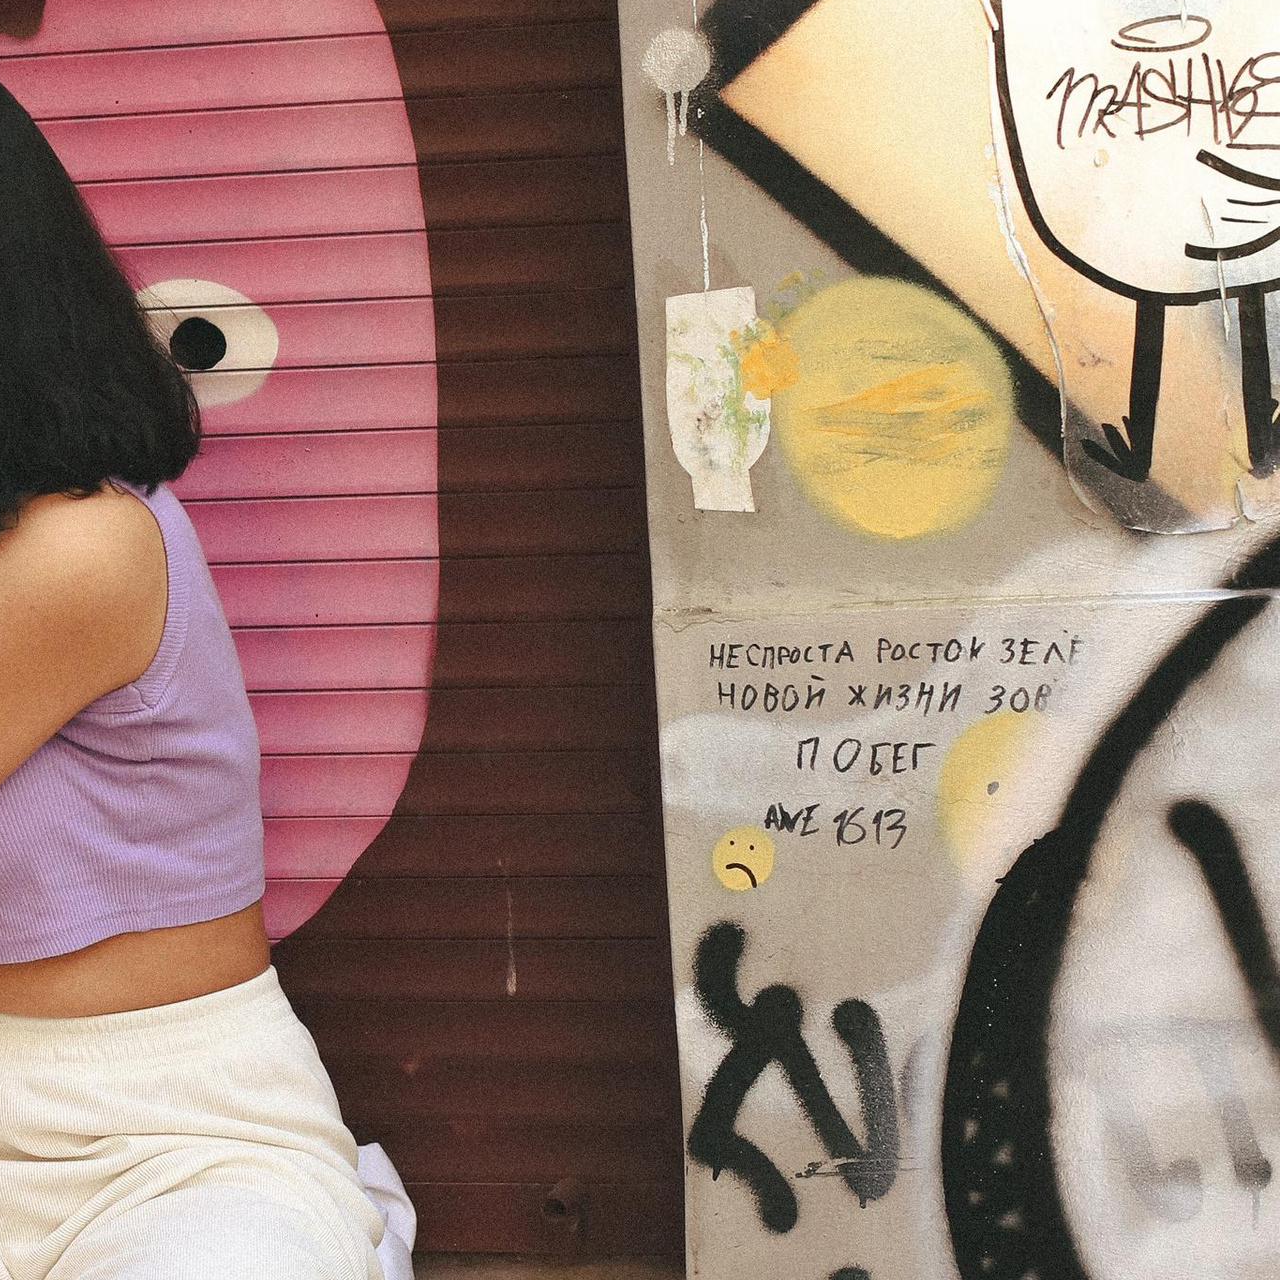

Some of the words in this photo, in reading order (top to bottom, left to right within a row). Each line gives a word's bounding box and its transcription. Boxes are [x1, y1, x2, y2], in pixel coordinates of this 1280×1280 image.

[709, 640, 855, 670] НЕСПРОСТА
[877, 636, 986, 664] РОСТОК
[718, 674, 827, 713] НОВОЙ
[848, 682, 961, 717] ЖИЗНИ
